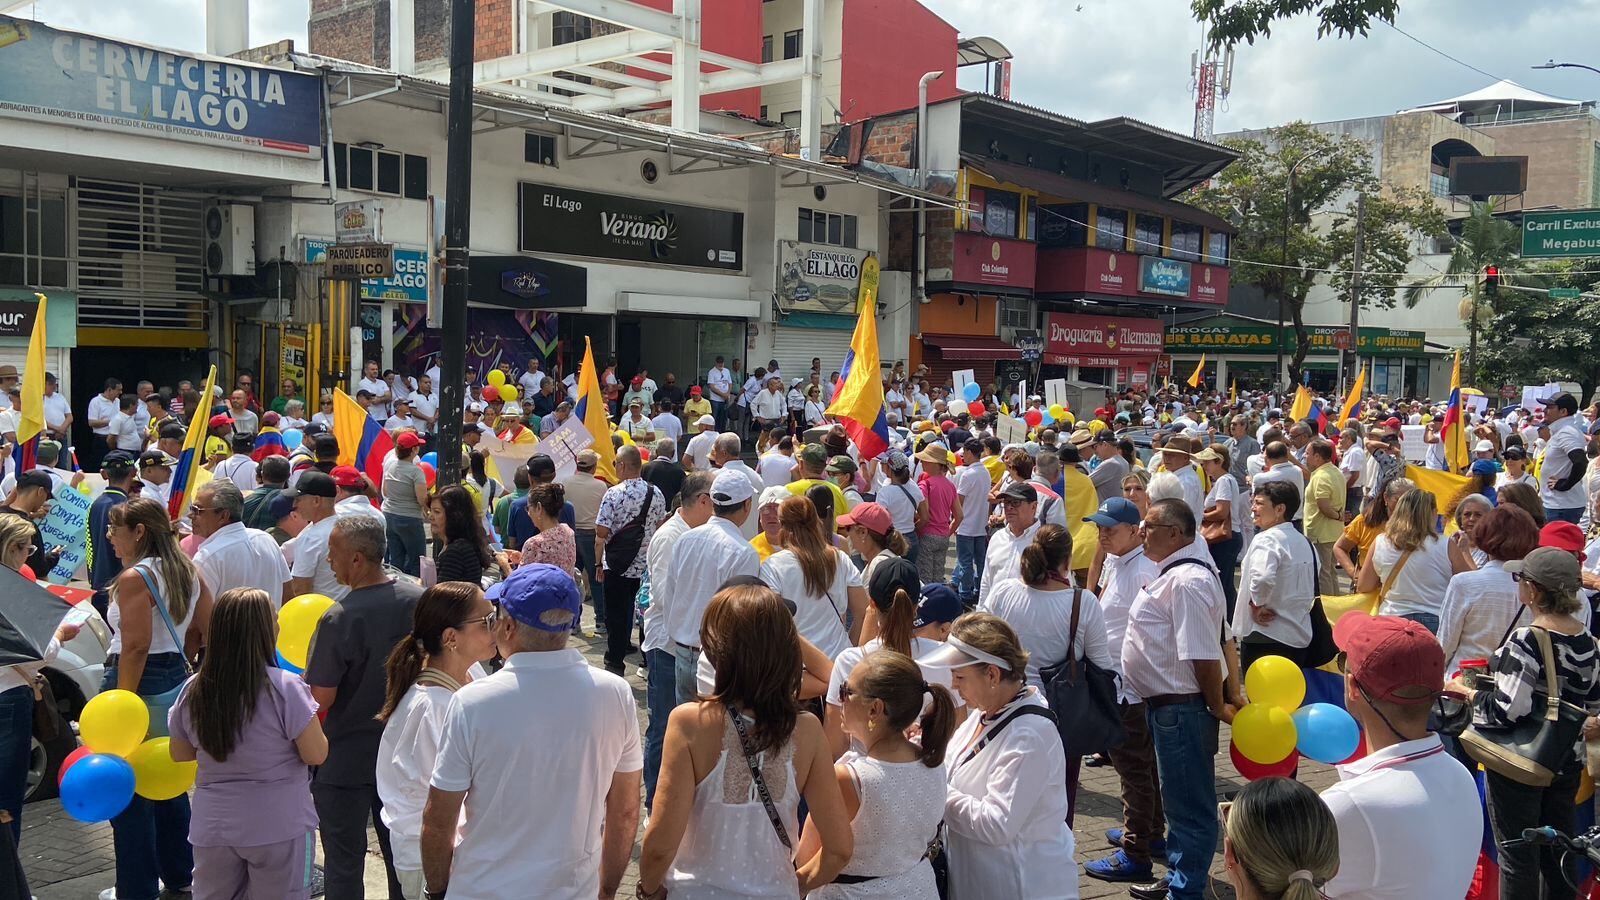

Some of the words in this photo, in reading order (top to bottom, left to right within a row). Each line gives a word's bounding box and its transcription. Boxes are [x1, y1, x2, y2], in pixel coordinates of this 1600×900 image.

[52, 35, 286, 105] CERVECERIA
[96, 77, 137, 114] EL
[152, 85, 248, 131] LAGO
[48, 108, 76, 119] MENORES
[77, 112, 86, 120] DE
[111, 118, 131, 127] EXCESO
[133, 120, 140, 128] DE
[543, 194, 554, 207] El
[556, 196, 582, 212] Lago
[600, 211, 668, 241] Verano
[1527, 220, 1560, 230] Carril
[329, 247, 389, 260] PARQUEADERO
[1543, 238, 1600, 252] Megabus
[811, 251, 855, 264] ESTANQUILLO
[332, 263, 384, 275] PUBLICO
[806, 260, 822, 276] EL
[824, 262, 858, 279] LAGO
[383, 274, 426, 288] LAGO
[1051, 323, 1103, 346] Droguería
[1120, 328, 1162, 345] Alemana
[1190, 334, 1272, 344] BARATAS
[38, 518, 76, 543] PRUEBAS
